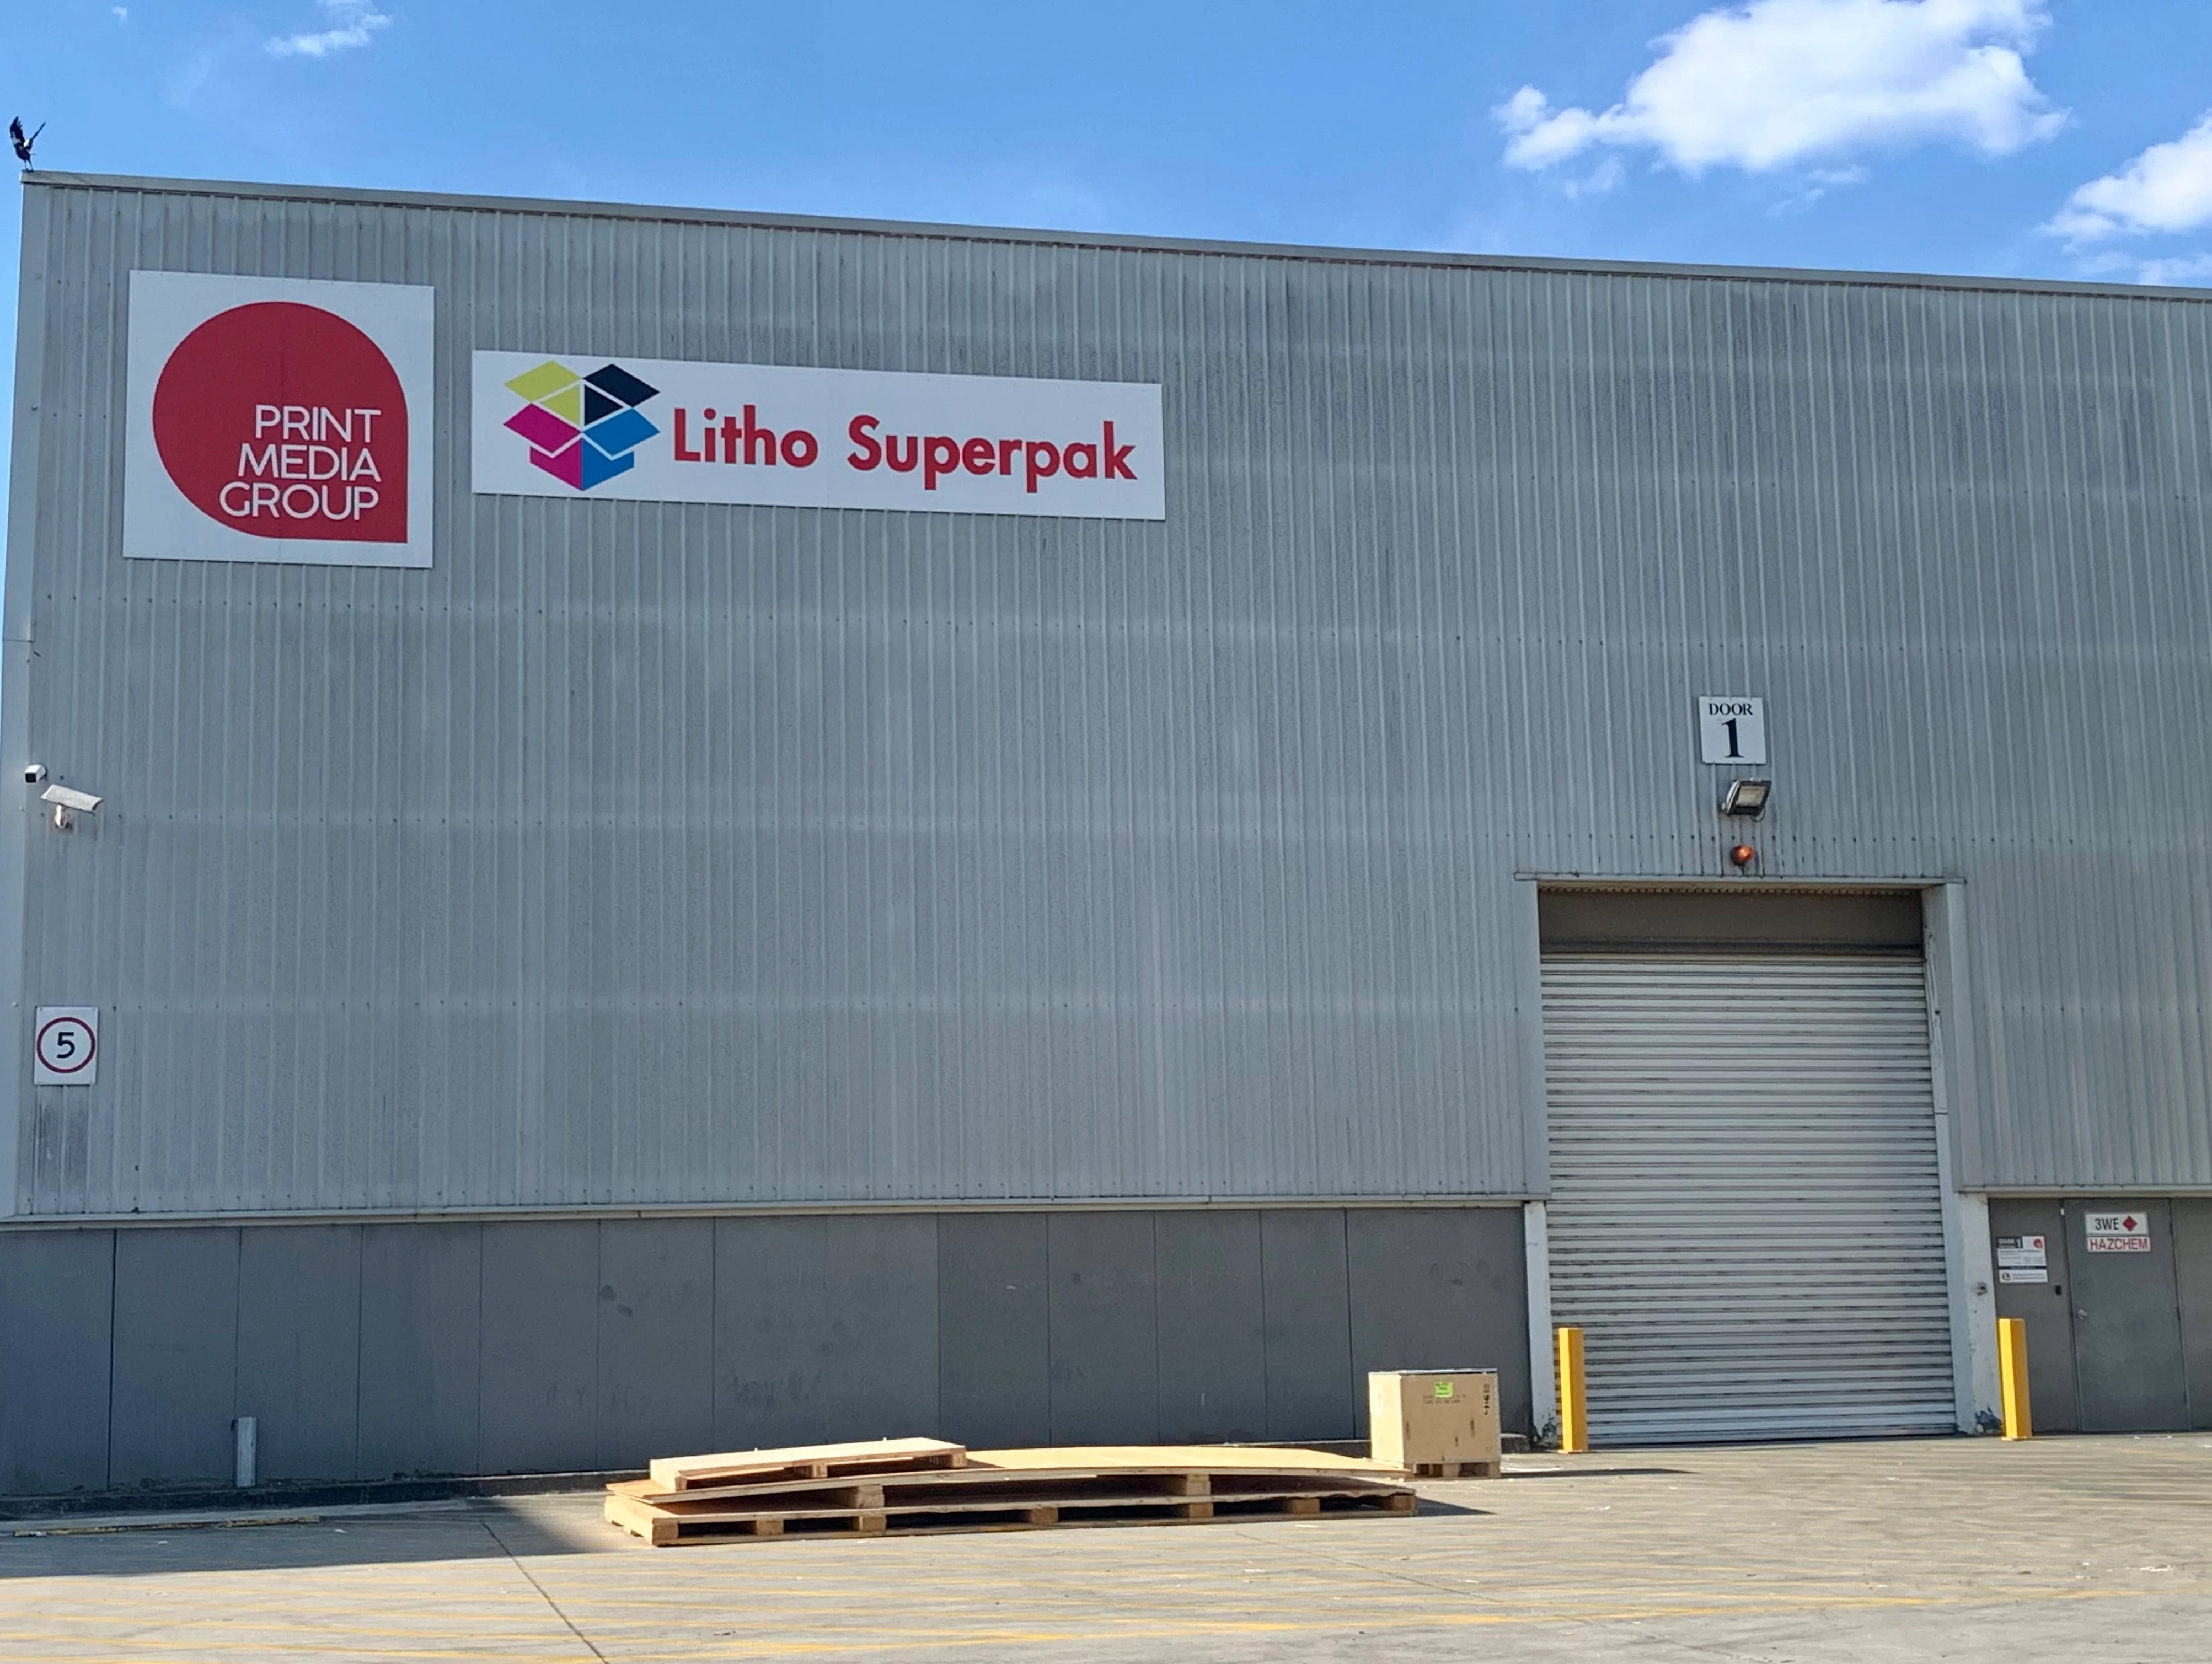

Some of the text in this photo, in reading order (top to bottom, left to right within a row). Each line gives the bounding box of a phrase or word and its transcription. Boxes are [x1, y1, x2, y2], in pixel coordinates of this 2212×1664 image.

[255, 404, 381, 443] PRINT
[238, 443, 382, 482] MEDIA
[674, 404, 1138, 493] Litho Superpak
[219, 481, 379, 520] GROUP
[1709, 703, 1753, 716] DOOR
[1721, 718, 1744, 758] 1
[56, 1032, 75, 1059] 5
[2095, 1217, 2119, 1230] 3WE
[2090, 1238, 2148, 1250] HAZCHEM
